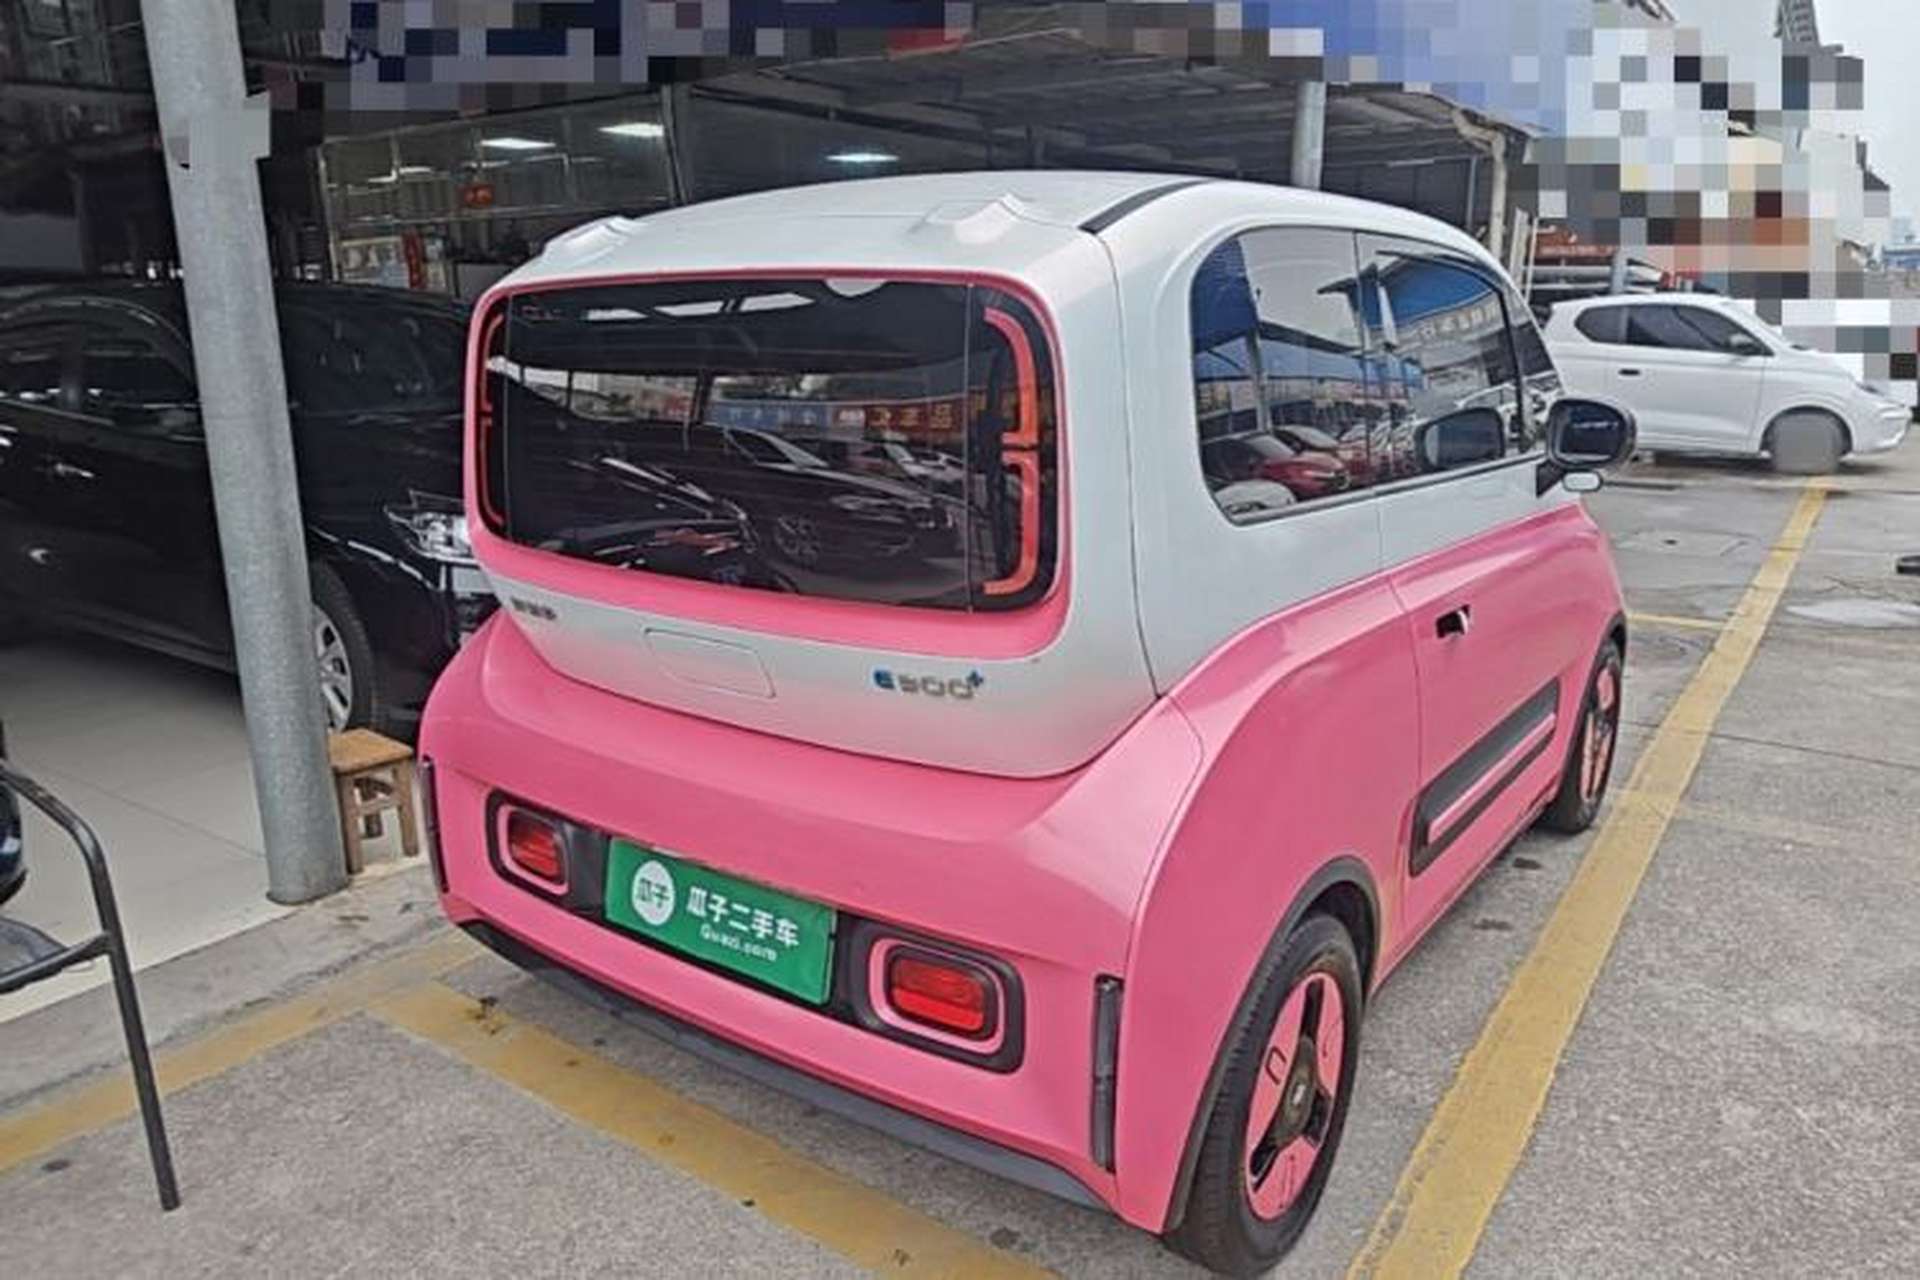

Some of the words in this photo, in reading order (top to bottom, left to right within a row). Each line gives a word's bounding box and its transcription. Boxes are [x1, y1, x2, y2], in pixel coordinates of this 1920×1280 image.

[638, 877, 671, 909] 瓜子
[686, 885, 799, 947] 瓜子二手车
